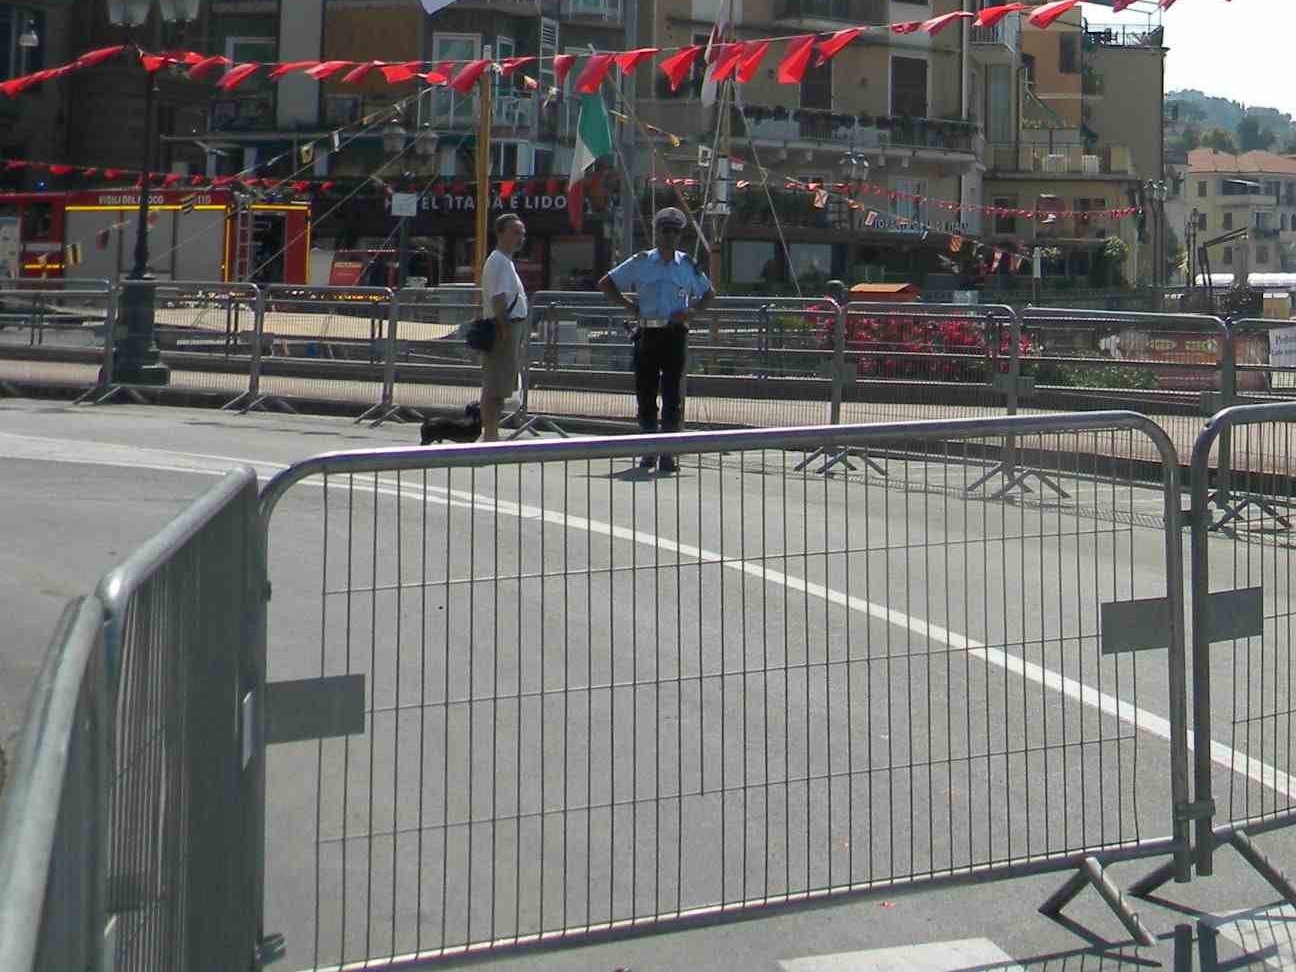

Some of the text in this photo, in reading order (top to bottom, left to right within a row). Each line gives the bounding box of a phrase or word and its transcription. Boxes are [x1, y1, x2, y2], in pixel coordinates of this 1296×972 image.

[385, 195, 568, 210] HEL ITAIA E LIDO
